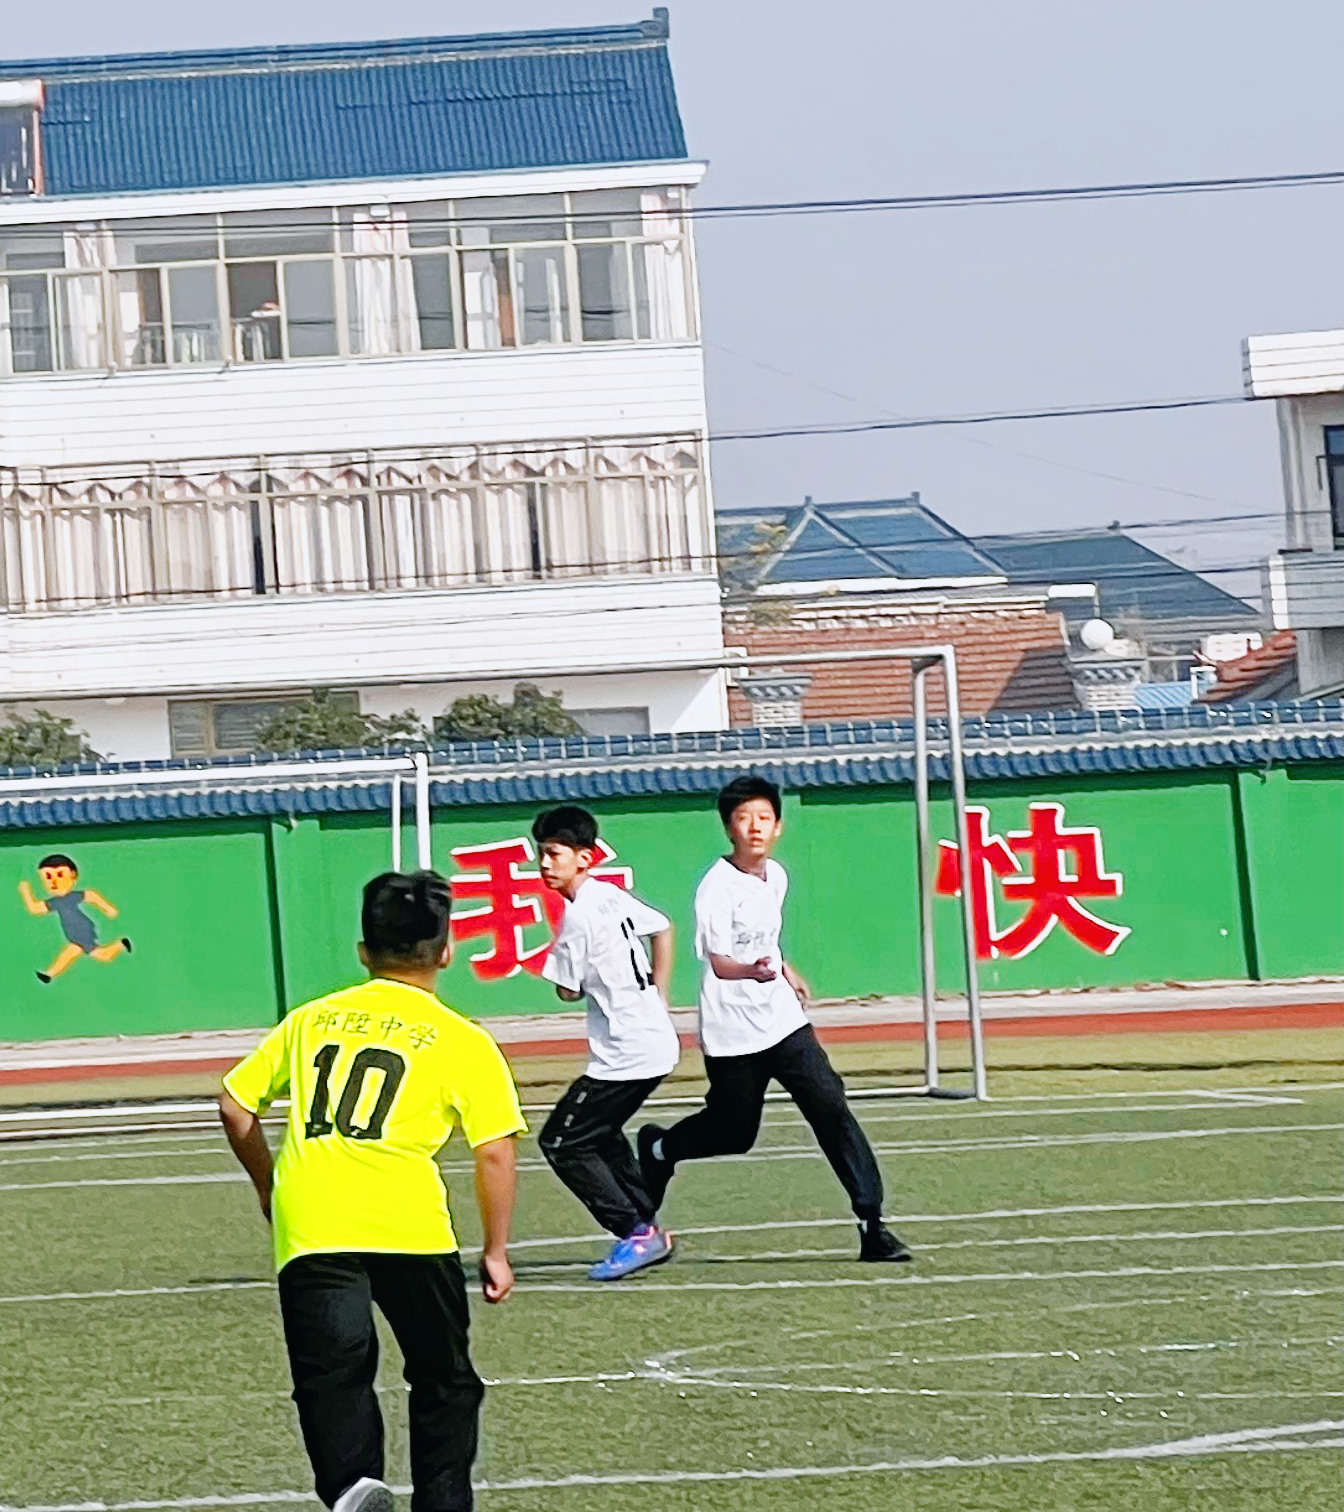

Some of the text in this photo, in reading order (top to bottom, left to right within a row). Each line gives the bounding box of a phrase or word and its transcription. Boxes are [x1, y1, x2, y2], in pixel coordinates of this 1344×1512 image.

[450, 802, 1132, 980] 我 快
[305, 1045, 406, 1139] 10
